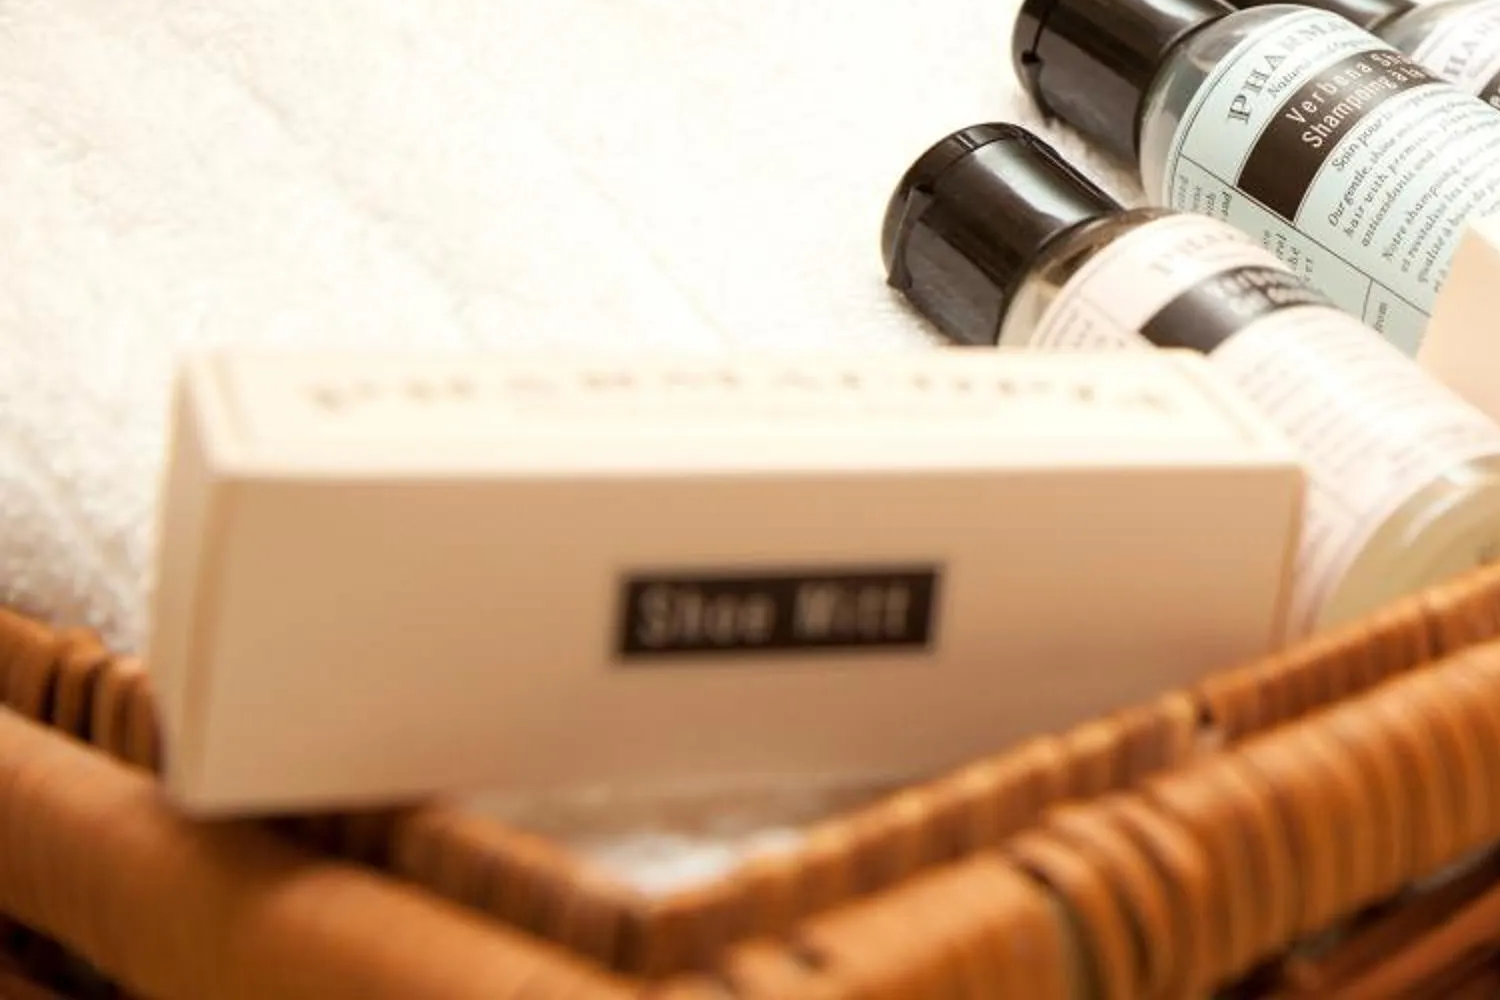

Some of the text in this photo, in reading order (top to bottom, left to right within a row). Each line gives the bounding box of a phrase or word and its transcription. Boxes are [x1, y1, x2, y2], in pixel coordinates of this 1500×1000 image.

[1227, 19, 1350, 125] PHARMA
[1285, 61, 1373, 124] Verbena
[1301, 75, 1398, 149] Shampoing
[1328, 202, 1345, 227] Our
[1342, 205, 1365, 238] hair
[1364, 173, 1389, 203] with
